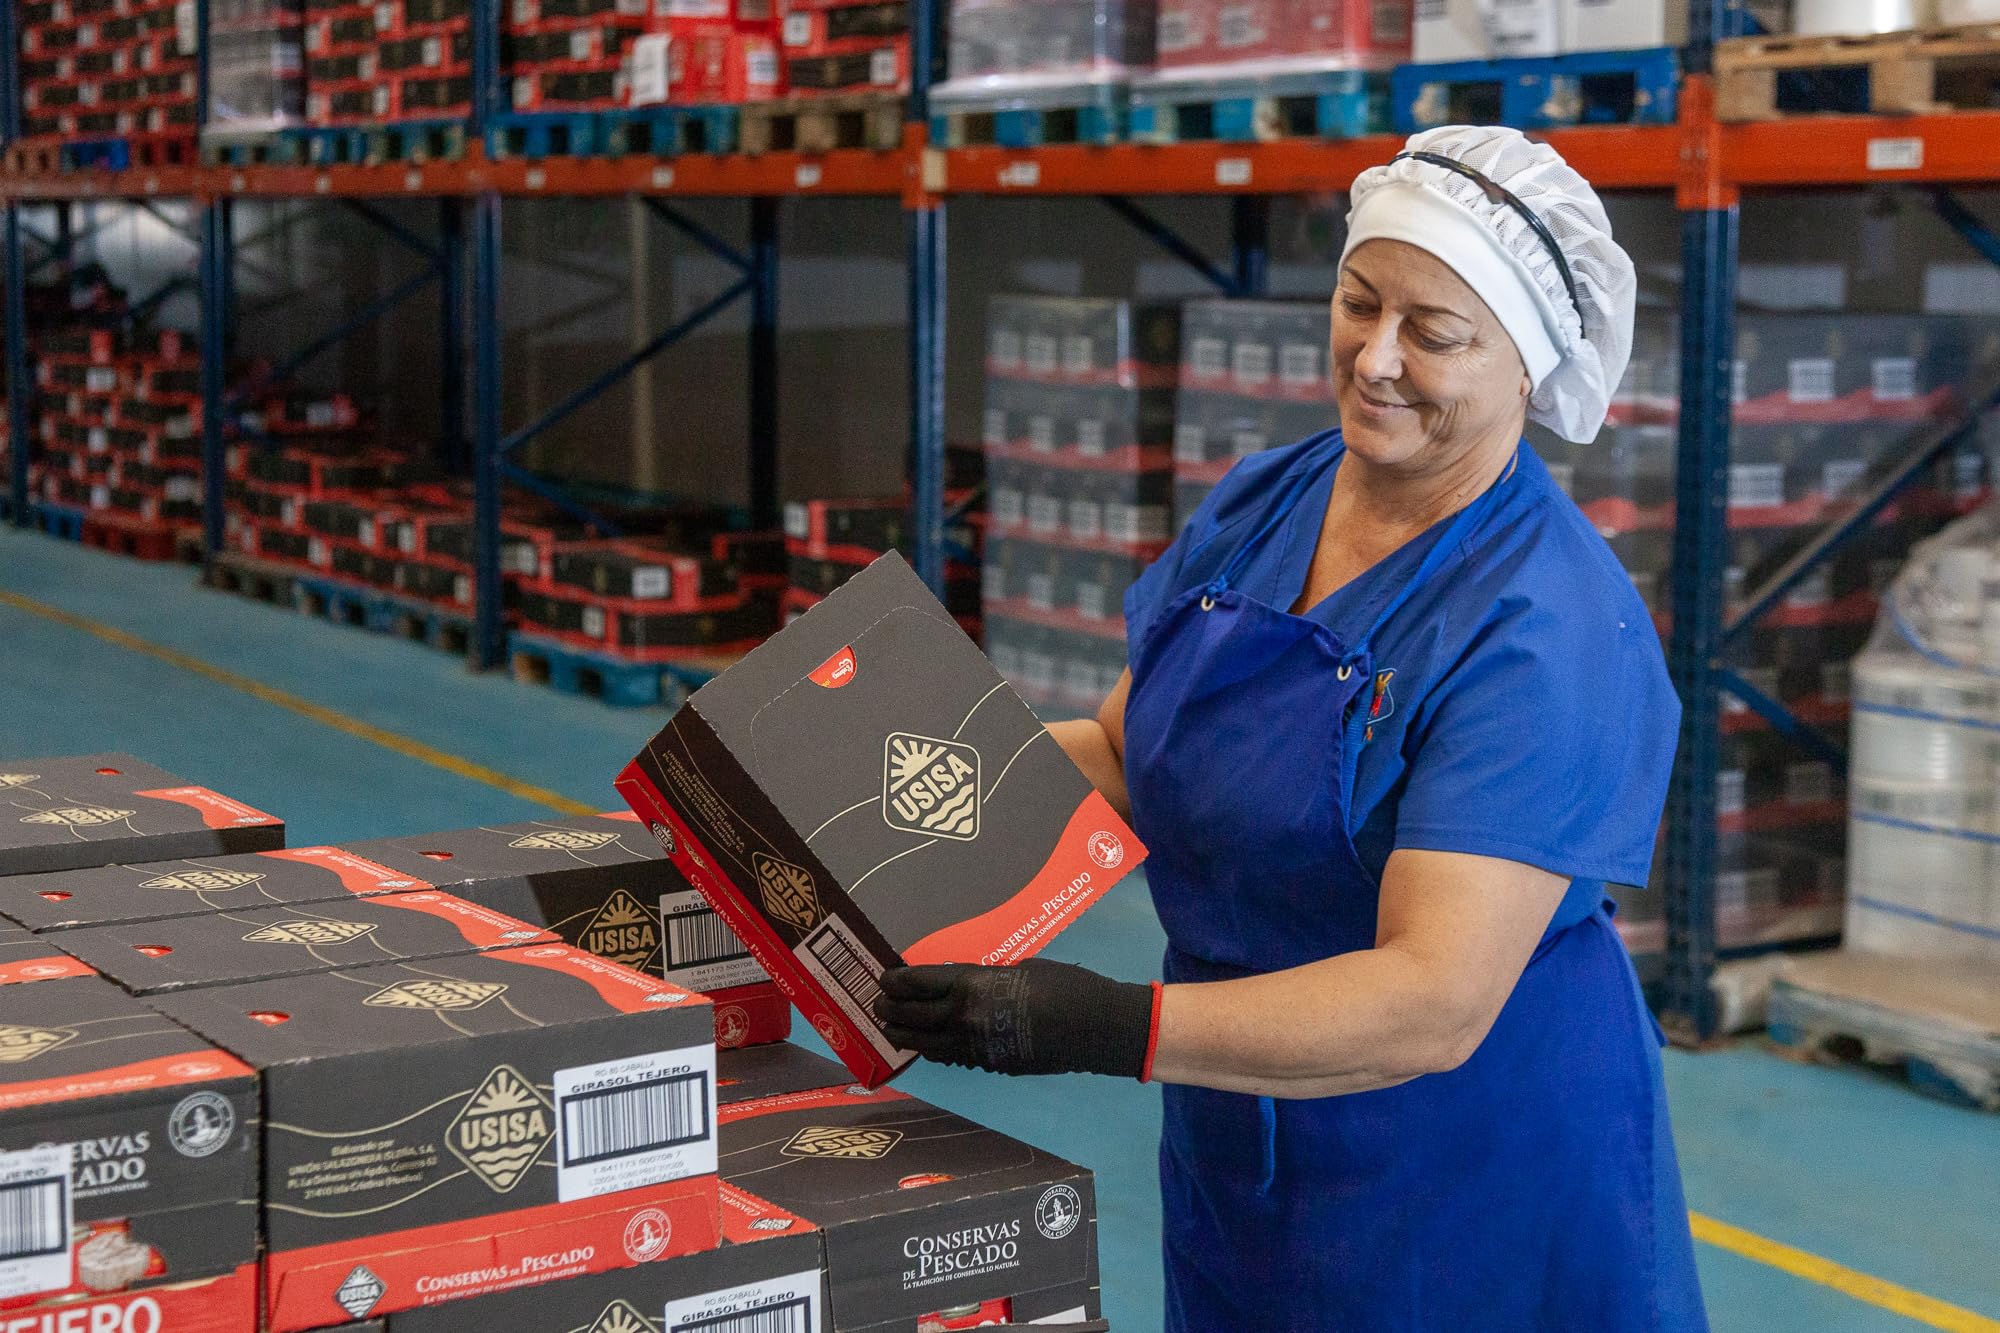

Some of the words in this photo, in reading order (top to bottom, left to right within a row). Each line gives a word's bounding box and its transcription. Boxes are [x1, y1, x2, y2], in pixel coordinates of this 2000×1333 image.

[892, 753, 974, 821] USISA
[653, 823, 673, 851] USISA
[673, 902, 708, 913] GIRAS
[761, 860, 814, 927] USISA
[981, 917, 1039, 966] CONSERVAS
[1042, 872, 1091, 916] PESCADO
[1030, 935, 1038, 944] DE
[1037, 911, 1065, 939] CONSERVAR
[1064, 905, 1072, 914] LO
[1070, 886, 1094, 908] NATURAL
[589, 924, 655, 954] USISA
[691, 873, 744, 936] CONSERVAS
[750, 943, 795, 996] PESCADO
[837, 931, 876, 974] GIRASOL
[401, 981, 472, 1007] USISA
[571, 1076, 632, 1094] GIRASOL
[639, 1064, 691, 1082] TEJERO
[73, 1130, 150, 1162] ERVAS
[460, 1111, 547, 1150] USISA
[790, 1132, 891, 1153] USISA
[74, 1157, 146, 1188] ADO
[903, 1219, 1020, 1258] CONSERVAS
[416, 1265, 508, 1293] CONSERVAS
[522, 1246, 594, 1274] PESCADO
[902, 1270, 916, 1282] DE
[919, 1241, 1017, 1278] PESCADO
[912, 1275, 944, 1289] TRADICIÓN
[945, 1273, 953, 1281] DE
[953, 1267, 986, 1280] CONSERVAR
[986, 1264, 994, 1273] LO
[994, 1260, 1020, 1270] NATURAL
[339, 1283, 380, 1301] USISA
[682, 1304, 741, 1324] GIRASOL
[744, 1291, 795, 1311] TEJERO
[728, 1288, 762, 1302] CABALLA
